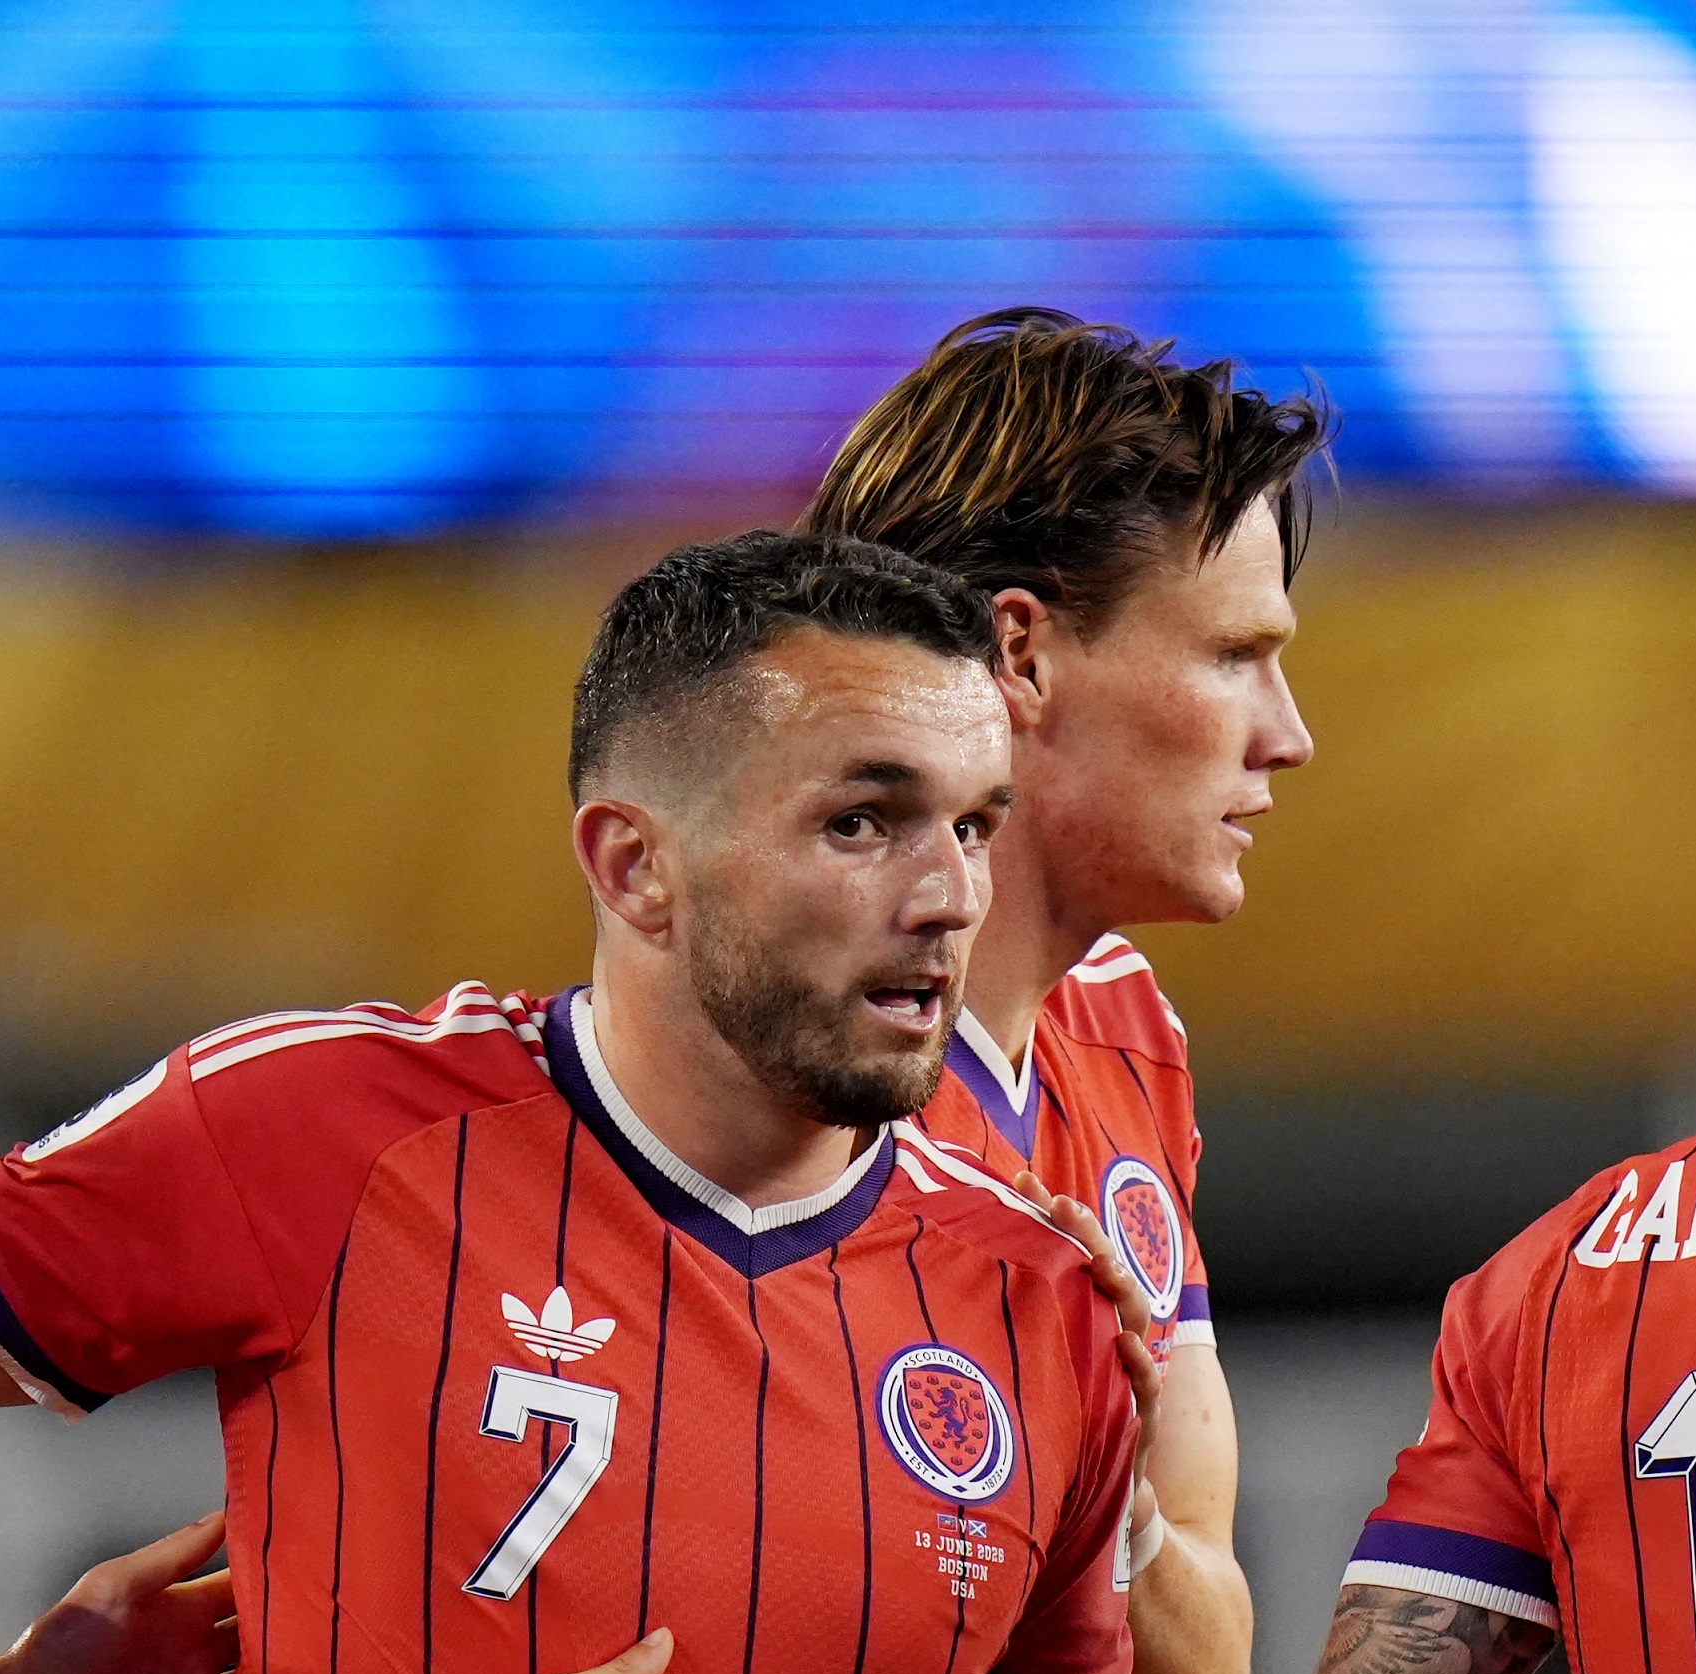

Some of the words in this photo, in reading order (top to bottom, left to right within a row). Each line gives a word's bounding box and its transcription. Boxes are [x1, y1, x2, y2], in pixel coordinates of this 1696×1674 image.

[908, 1351, 973, 1375] SCOTLAND
[461, 1363, 619, 1601] 7
[909, 1455, 929, 1475] EST
[985, 1471, 1002, 1490] 1873
[914, 1530, 931, 1548] 13
[936, 1535, 973, 1557] JUNE
[977, 1544, 1005, 1564] 2026
[938, 1556, 988, 1582] BOSTON
[951, 1579, 975, 1599] USA
